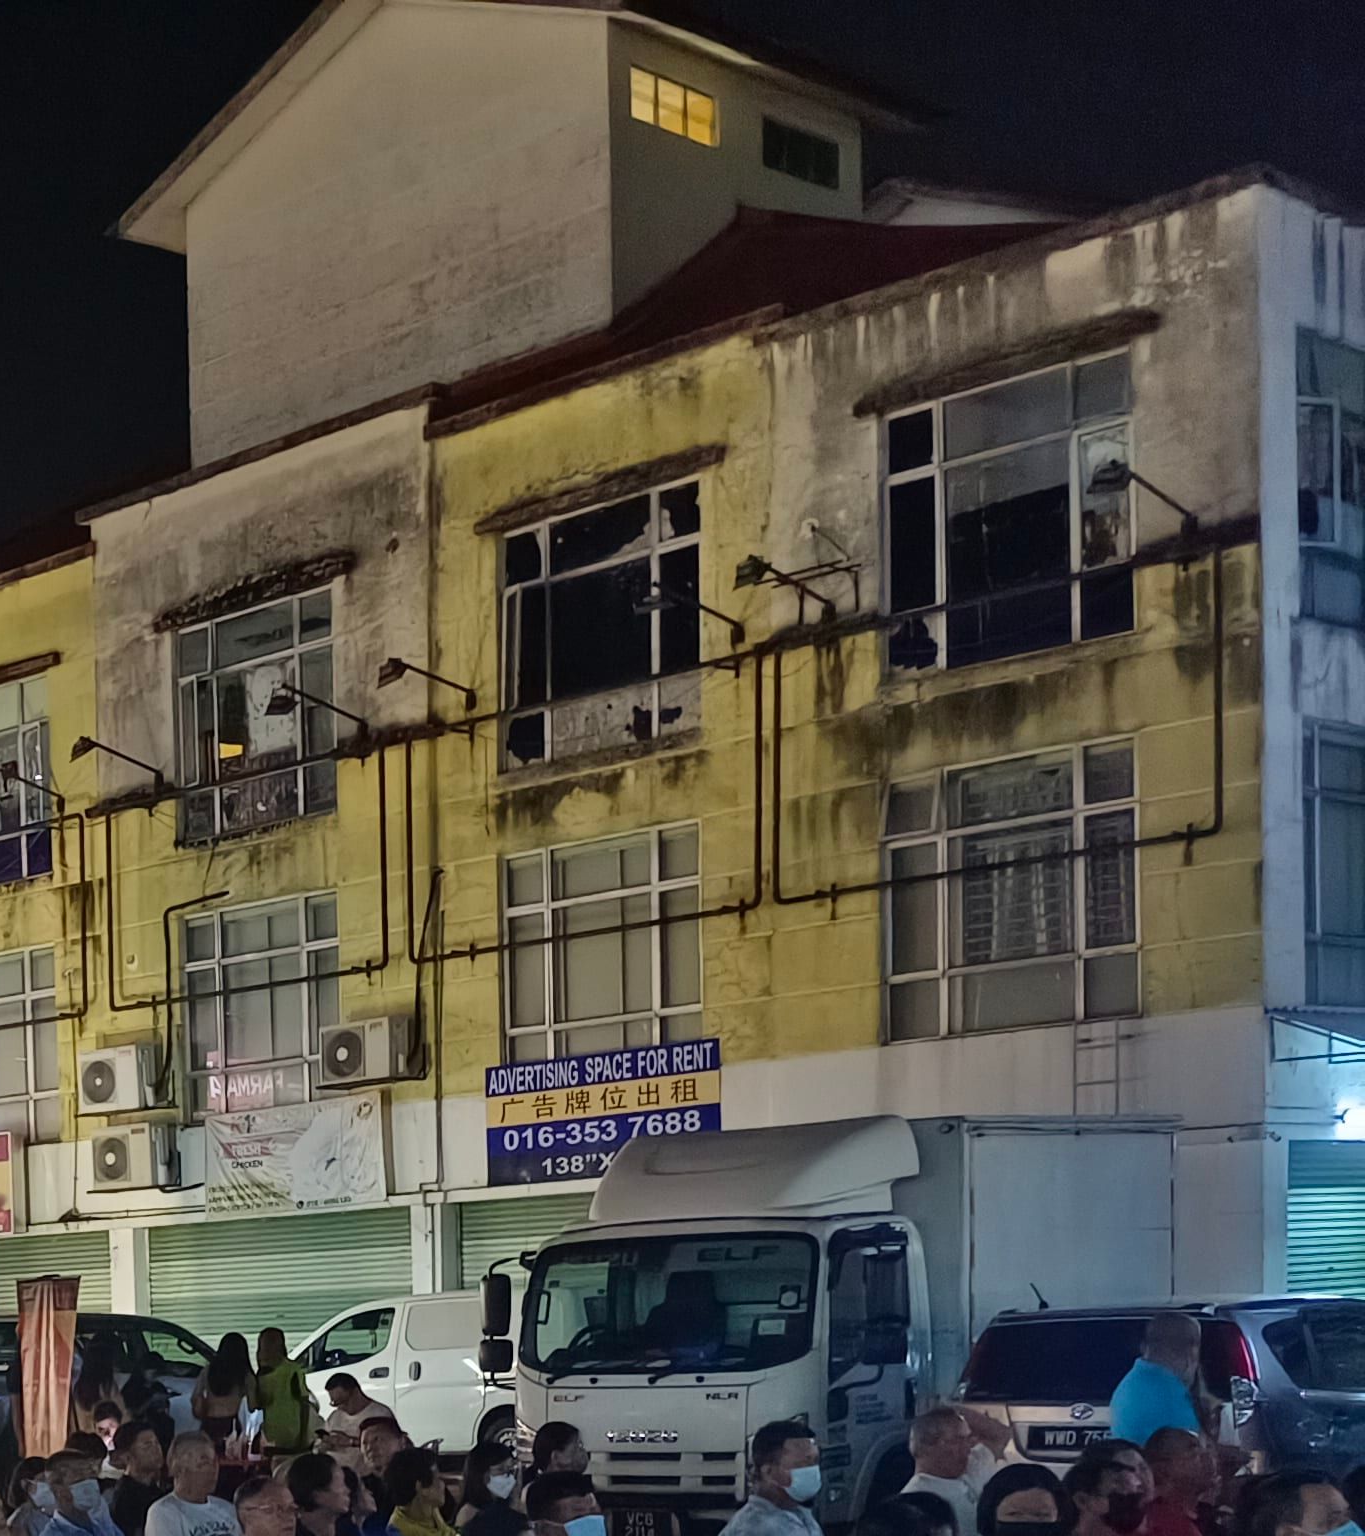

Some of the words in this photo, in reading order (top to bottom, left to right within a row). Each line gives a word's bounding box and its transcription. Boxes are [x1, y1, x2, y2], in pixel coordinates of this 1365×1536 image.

[488, 1060, 579, 1095] ADVERTISING
[584, 1053, 632, 1084] SPACE
[637, 1048, 668, 1076] FOR
[672, 1042, 714, 1072] RENT
[500, 1078, 699, 1123] 广告牌位出租
[503, 1119, 618, 1151] 016-353
[627, 1109, 702, 1138] 7688
